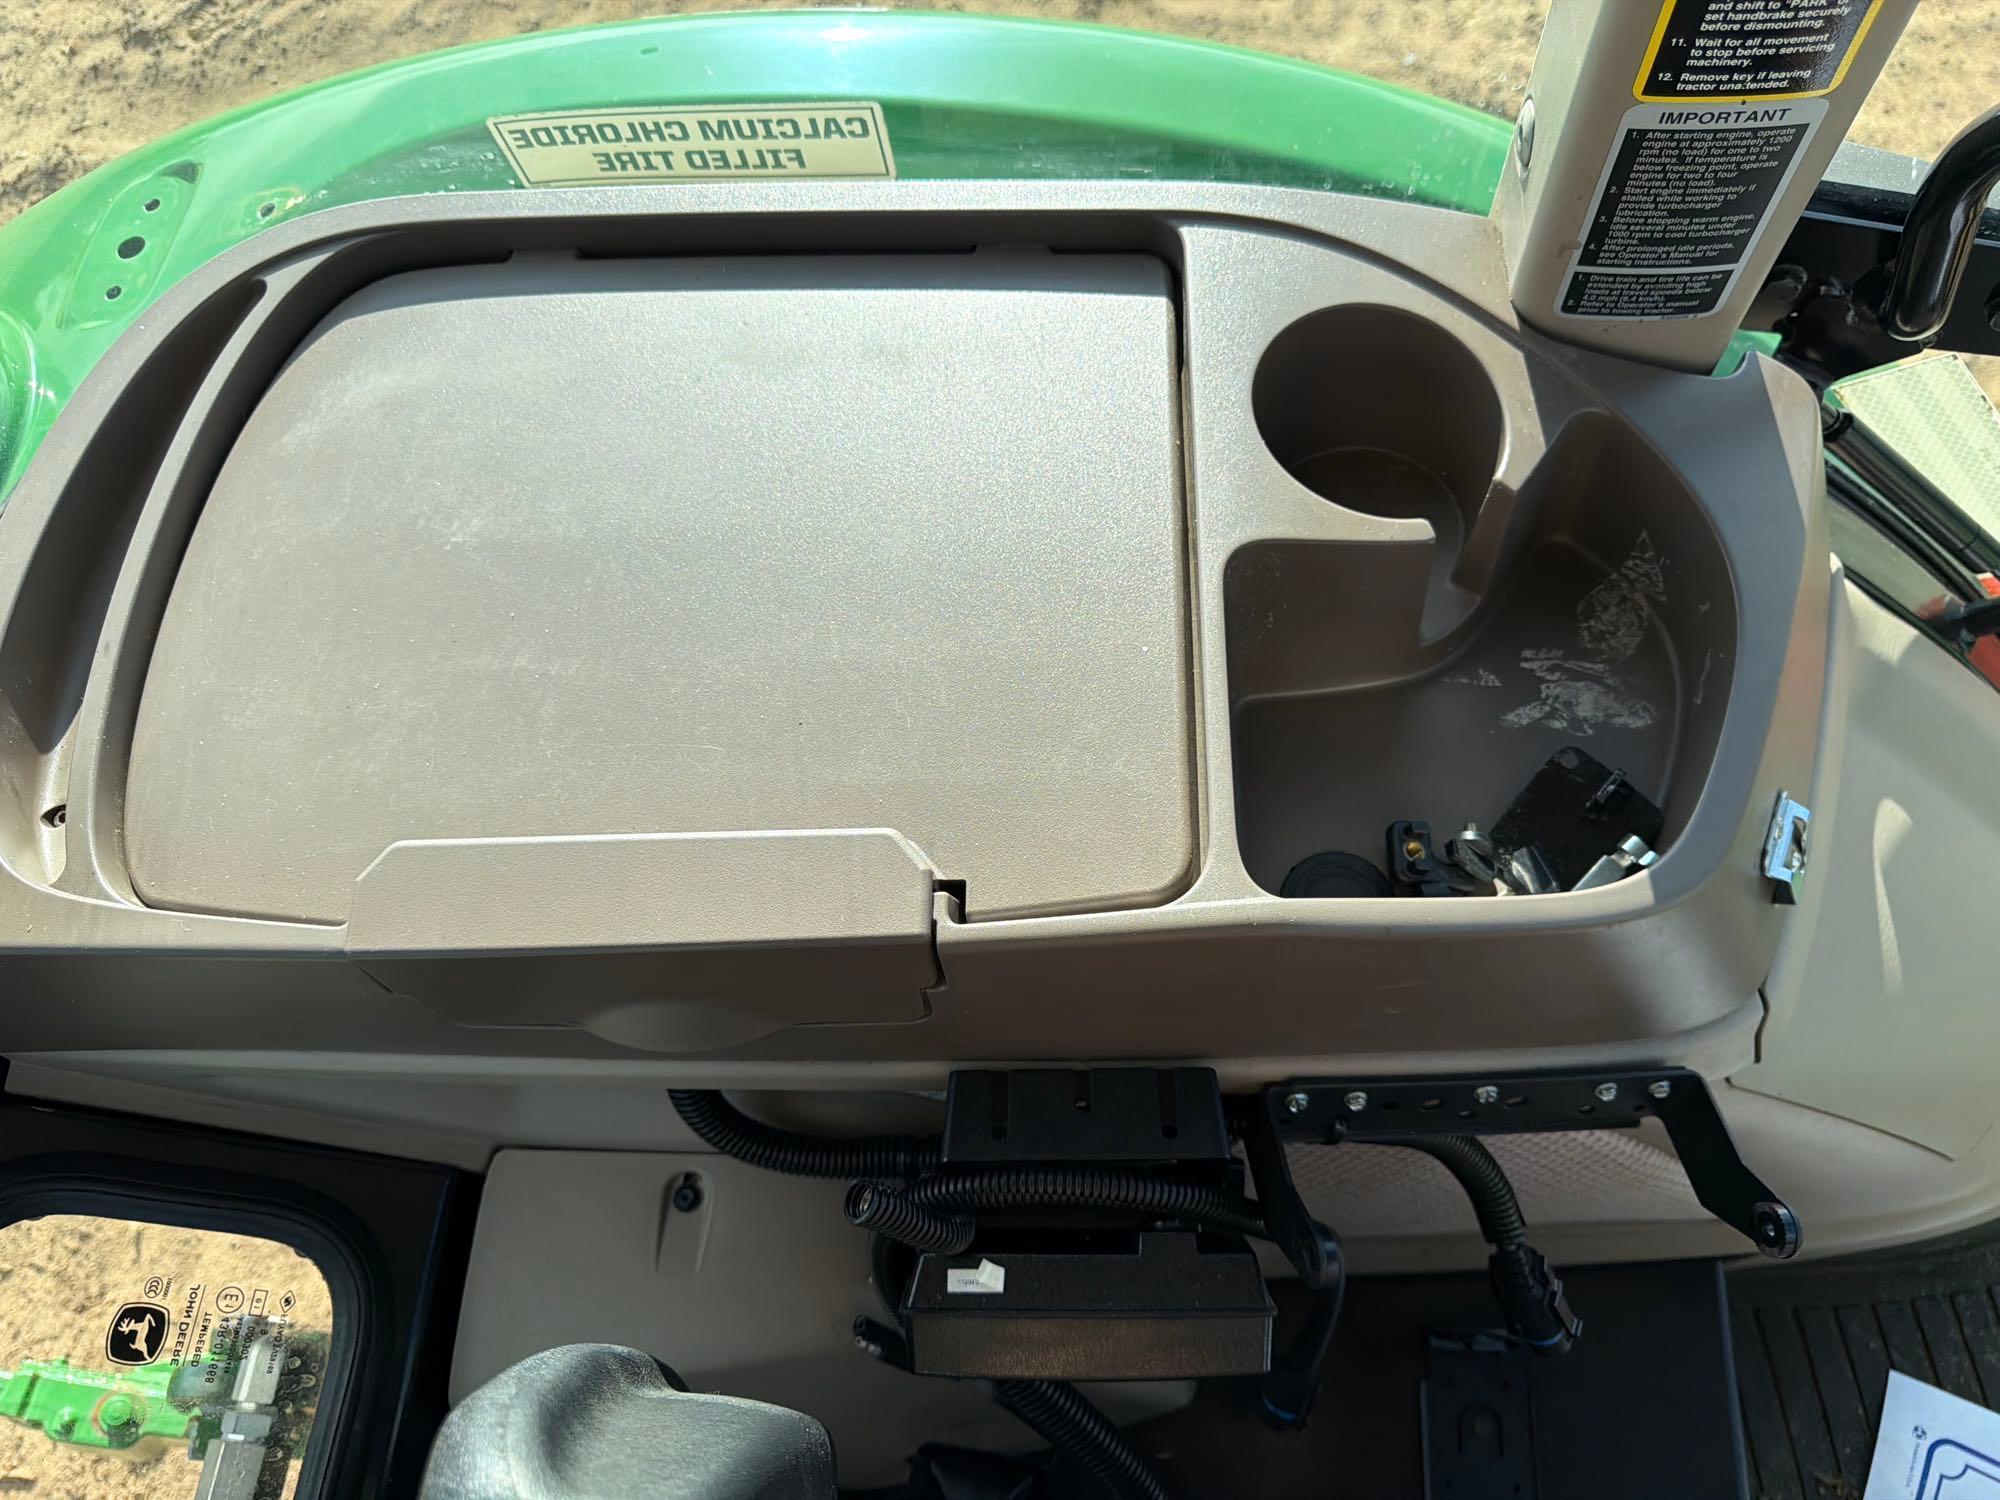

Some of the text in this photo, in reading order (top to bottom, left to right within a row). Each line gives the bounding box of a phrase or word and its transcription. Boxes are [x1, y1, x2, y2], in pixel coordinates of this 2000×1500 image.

[1708, 1, 1733, 11] and
[1735, 0, 1766, 10] shift
[1768, 1, 1782, 9] to
[1786, 0, 1834, 8] "PARK
[1704, 5, 1851, 21] set handbrake securely
[1700, 19, 1826, 31] before dismounting.
[1670, 33, 1829, 47] 11. Wait for all movement
[1690, 43, 1836, 59] to stop before servicing
[1685, 58, 1753, 68] machinery.
[1657, 69, 1812, 83] 12. Remove key if leaving
[1676, 80, 1790, 91] tractor unatended.
[1658, 108, 1793, 125] IMPORTANT
[1631, 131, 1640, 139] 1.
[1645, 131, 1672, 140] After
[1673, 130, 1714, 141] starting
[1756, 127, 1797, 138] operate
[1641, 135, 1794, 149] engine at approximately 1200
[1638, 144, 1782, 157] rpm (no load) for one to two
[1635, 153, 1768, 165] minutes. If temperature is
[1632, 160, 1780, 174] below freezing point, operate
[1629, 170, 1739, 181] engine for two to four
[1626, 178, 1716, 188] minutes (no load).
[1609, 183, 1757, 196] 2. Start engine immediately if
[1621, 192, 1738, 203] stalled while working to
[1617, 201, 1722, 210] provide turbocharger
[1615, 209, 1670, 217] lubrication.
[1599, 215, 1607, 223] 3.
[1612, 216, 1646, 224] Before
[1646, 216, 1690, 226] stopping
[1692, 216, 1719, 224] warm
[1609, 221, 1737, 232] idle several minutes under
[1608, 227, 1752, 240] 1000 rpm to cool turbocharger
[1604, 238, 1640, 246] turbine.
[1601, 244, 1625, 252] After
[1625, 245, 1677, 254] prolonged
[1678, 244, 1696, 252] idle
[1617, 251, 1668, 260] Operator's
[1669, 251, 1705, 259] Manual
